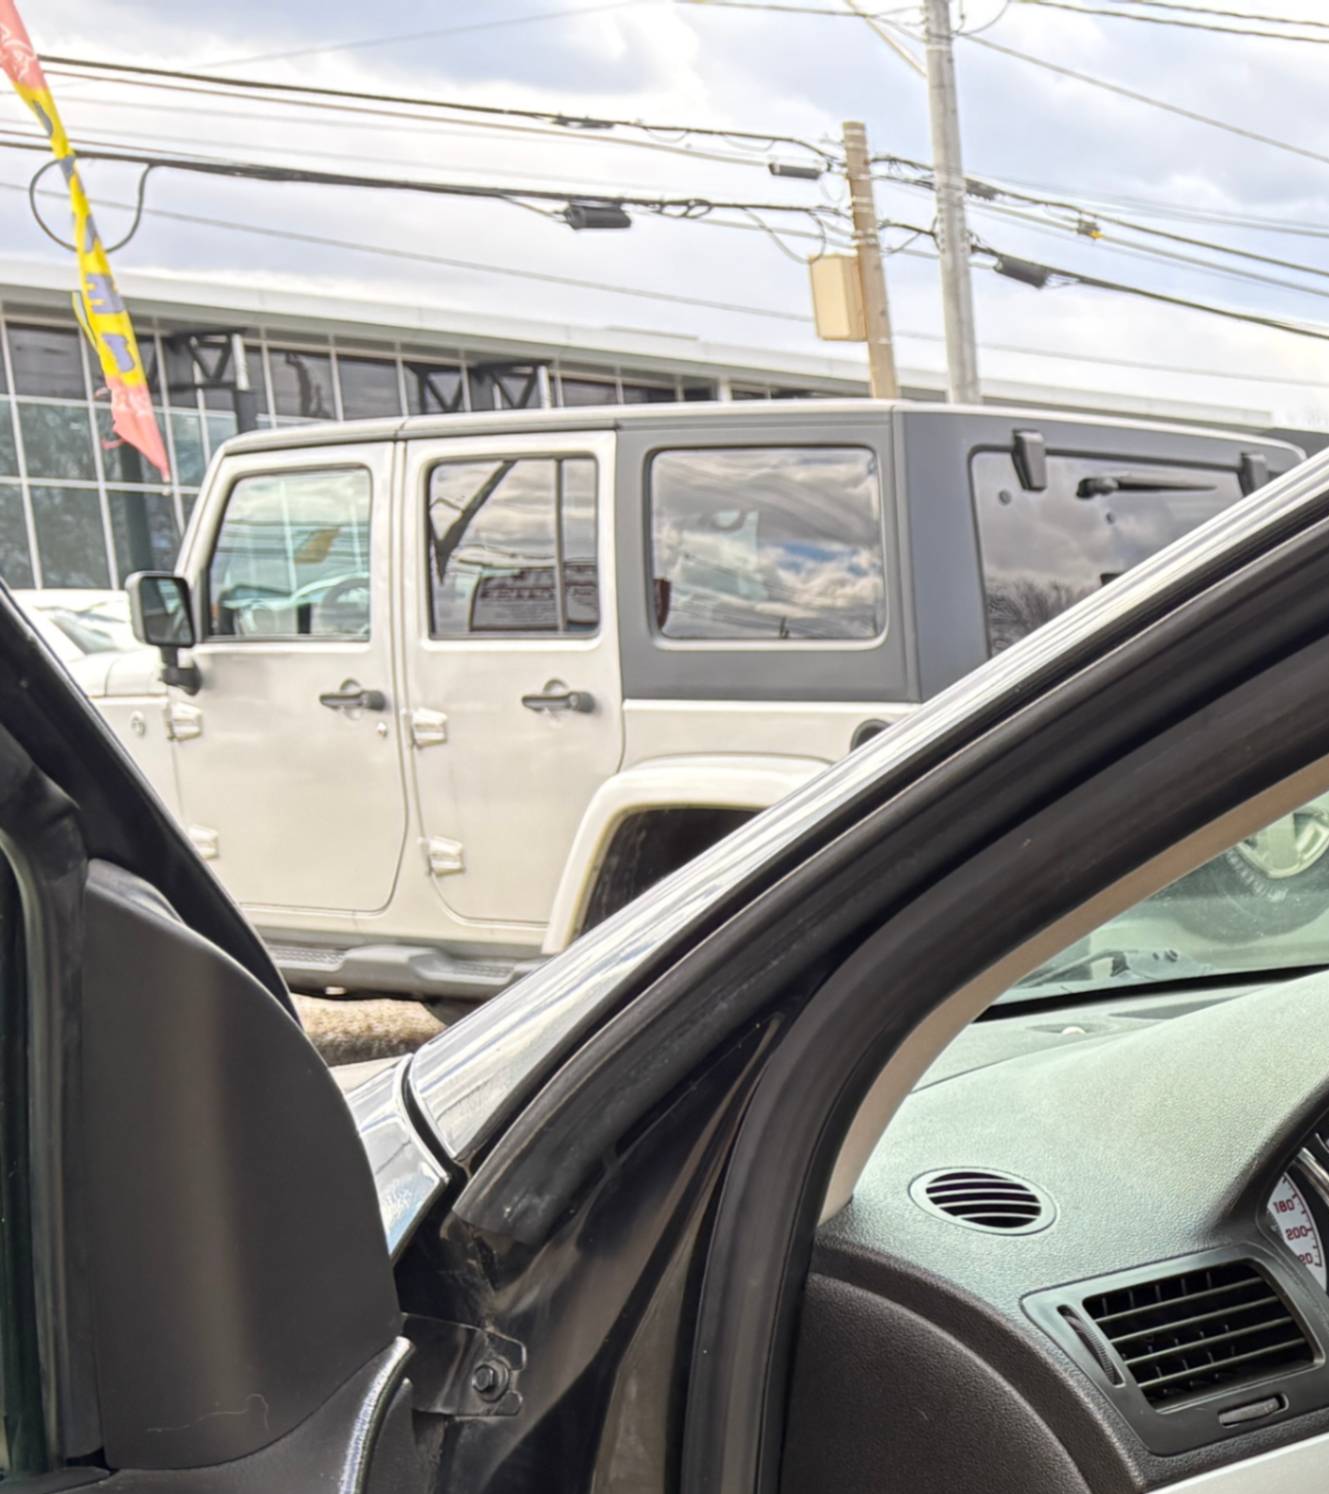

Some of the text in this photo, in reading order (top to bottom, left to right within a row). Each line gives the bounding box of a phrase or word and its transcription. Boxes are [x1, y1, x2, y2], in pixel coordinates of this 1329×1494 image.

[1272, 1200, 1295, 1213] 180
[1285, 1225, 1308, 1240] 200
[1299, 1253, 1313, 1265] 20
